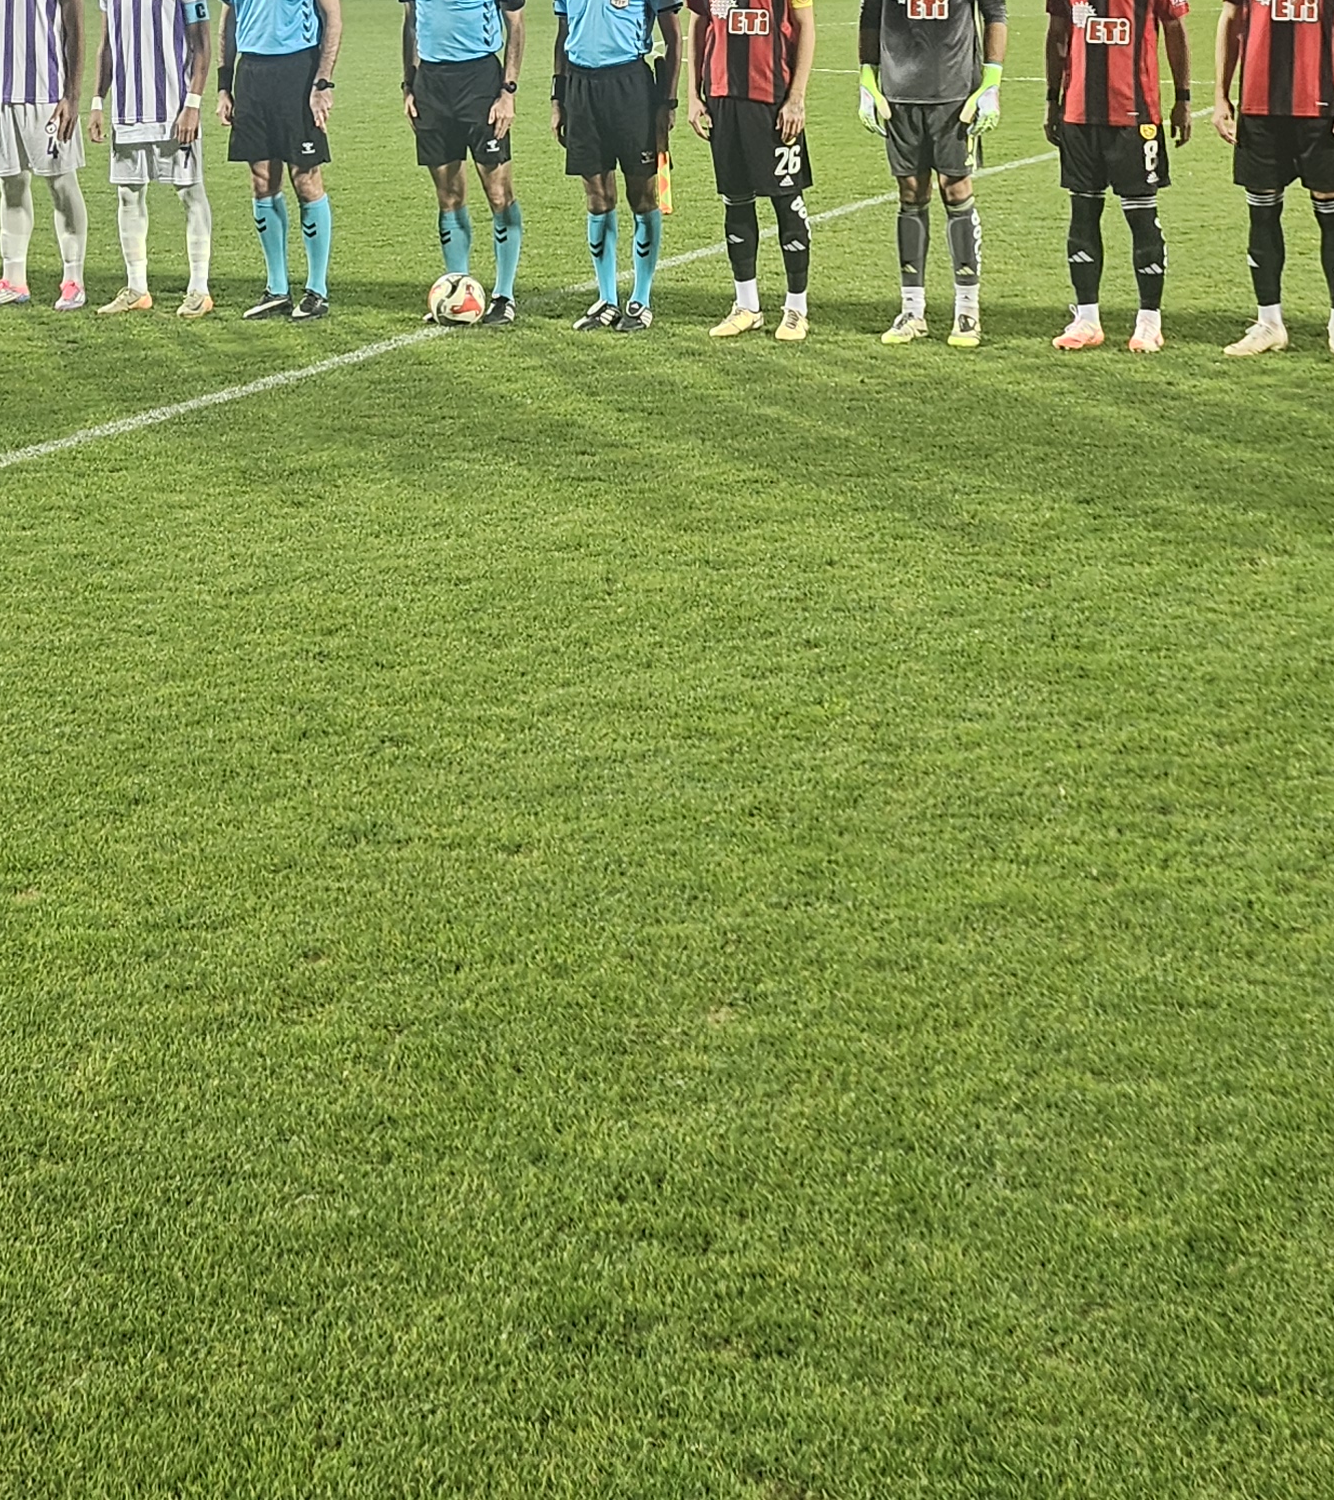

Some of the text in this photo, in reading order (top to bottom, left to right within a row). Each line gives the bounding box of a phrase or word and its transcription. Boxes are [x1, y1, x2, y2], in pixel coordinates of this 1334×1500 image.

[194, 2, 207, 19] C
[46, 136, 59, 160] 4
[774, 144, 801, 176] 26
[1144, 139, 1158, 171] 8
